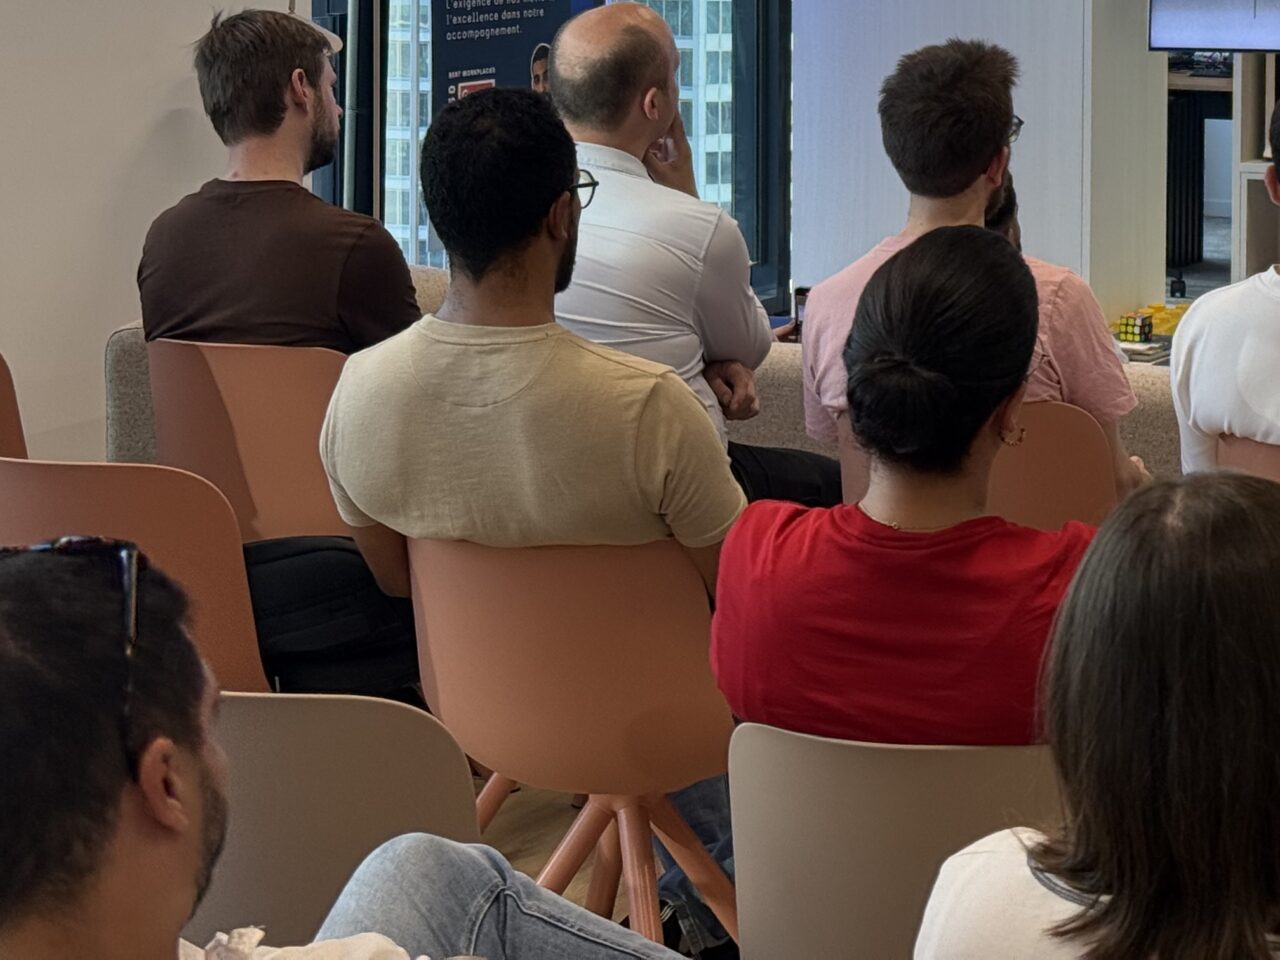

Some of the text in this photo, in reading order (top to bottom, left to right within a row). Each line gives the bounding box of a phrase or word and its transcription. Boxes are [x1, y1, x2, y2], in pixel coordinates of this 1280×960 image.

[446, 8, 544, 26] l'excellence dans notre
